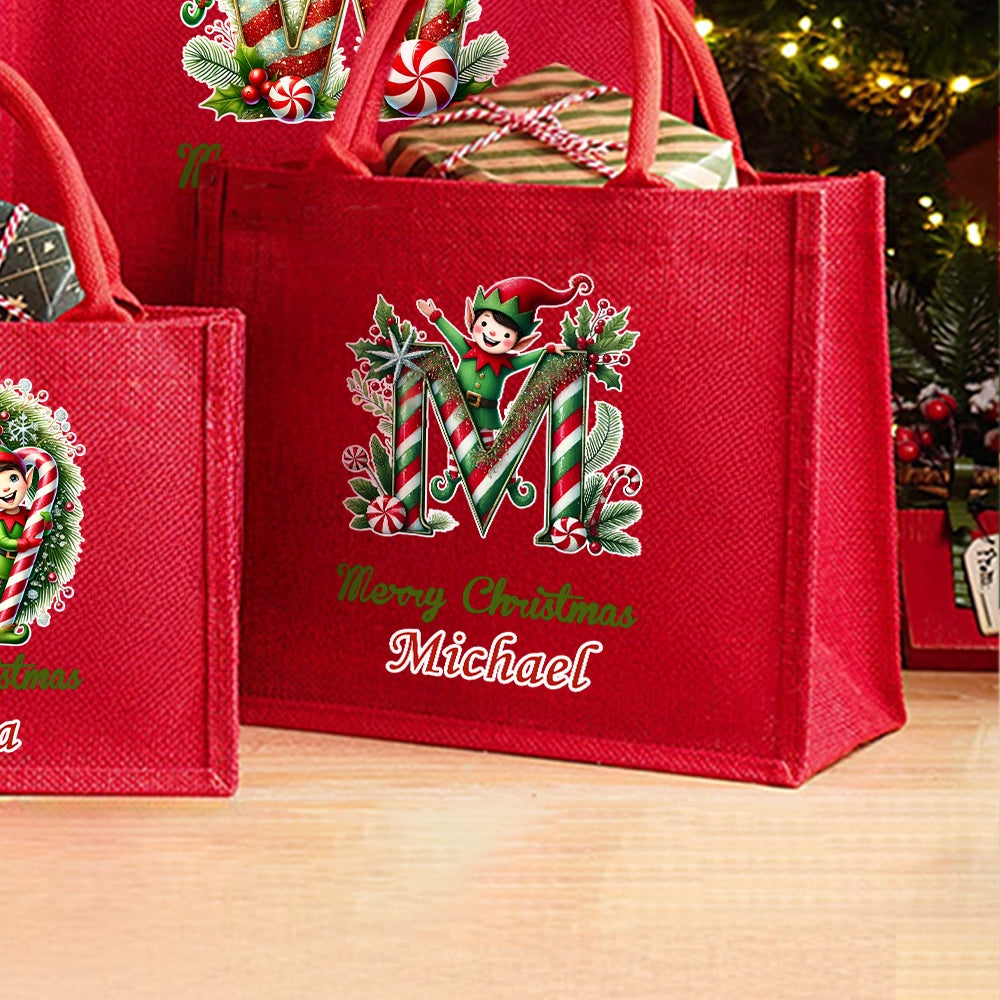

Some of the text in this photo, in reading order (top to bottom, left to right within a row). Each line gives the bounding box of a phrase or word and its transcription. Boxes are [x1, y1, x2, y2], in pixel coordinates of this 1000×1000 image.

[337, 563, 638, 629] Merry Christmas
[385, 628, 604, 692] Michael
